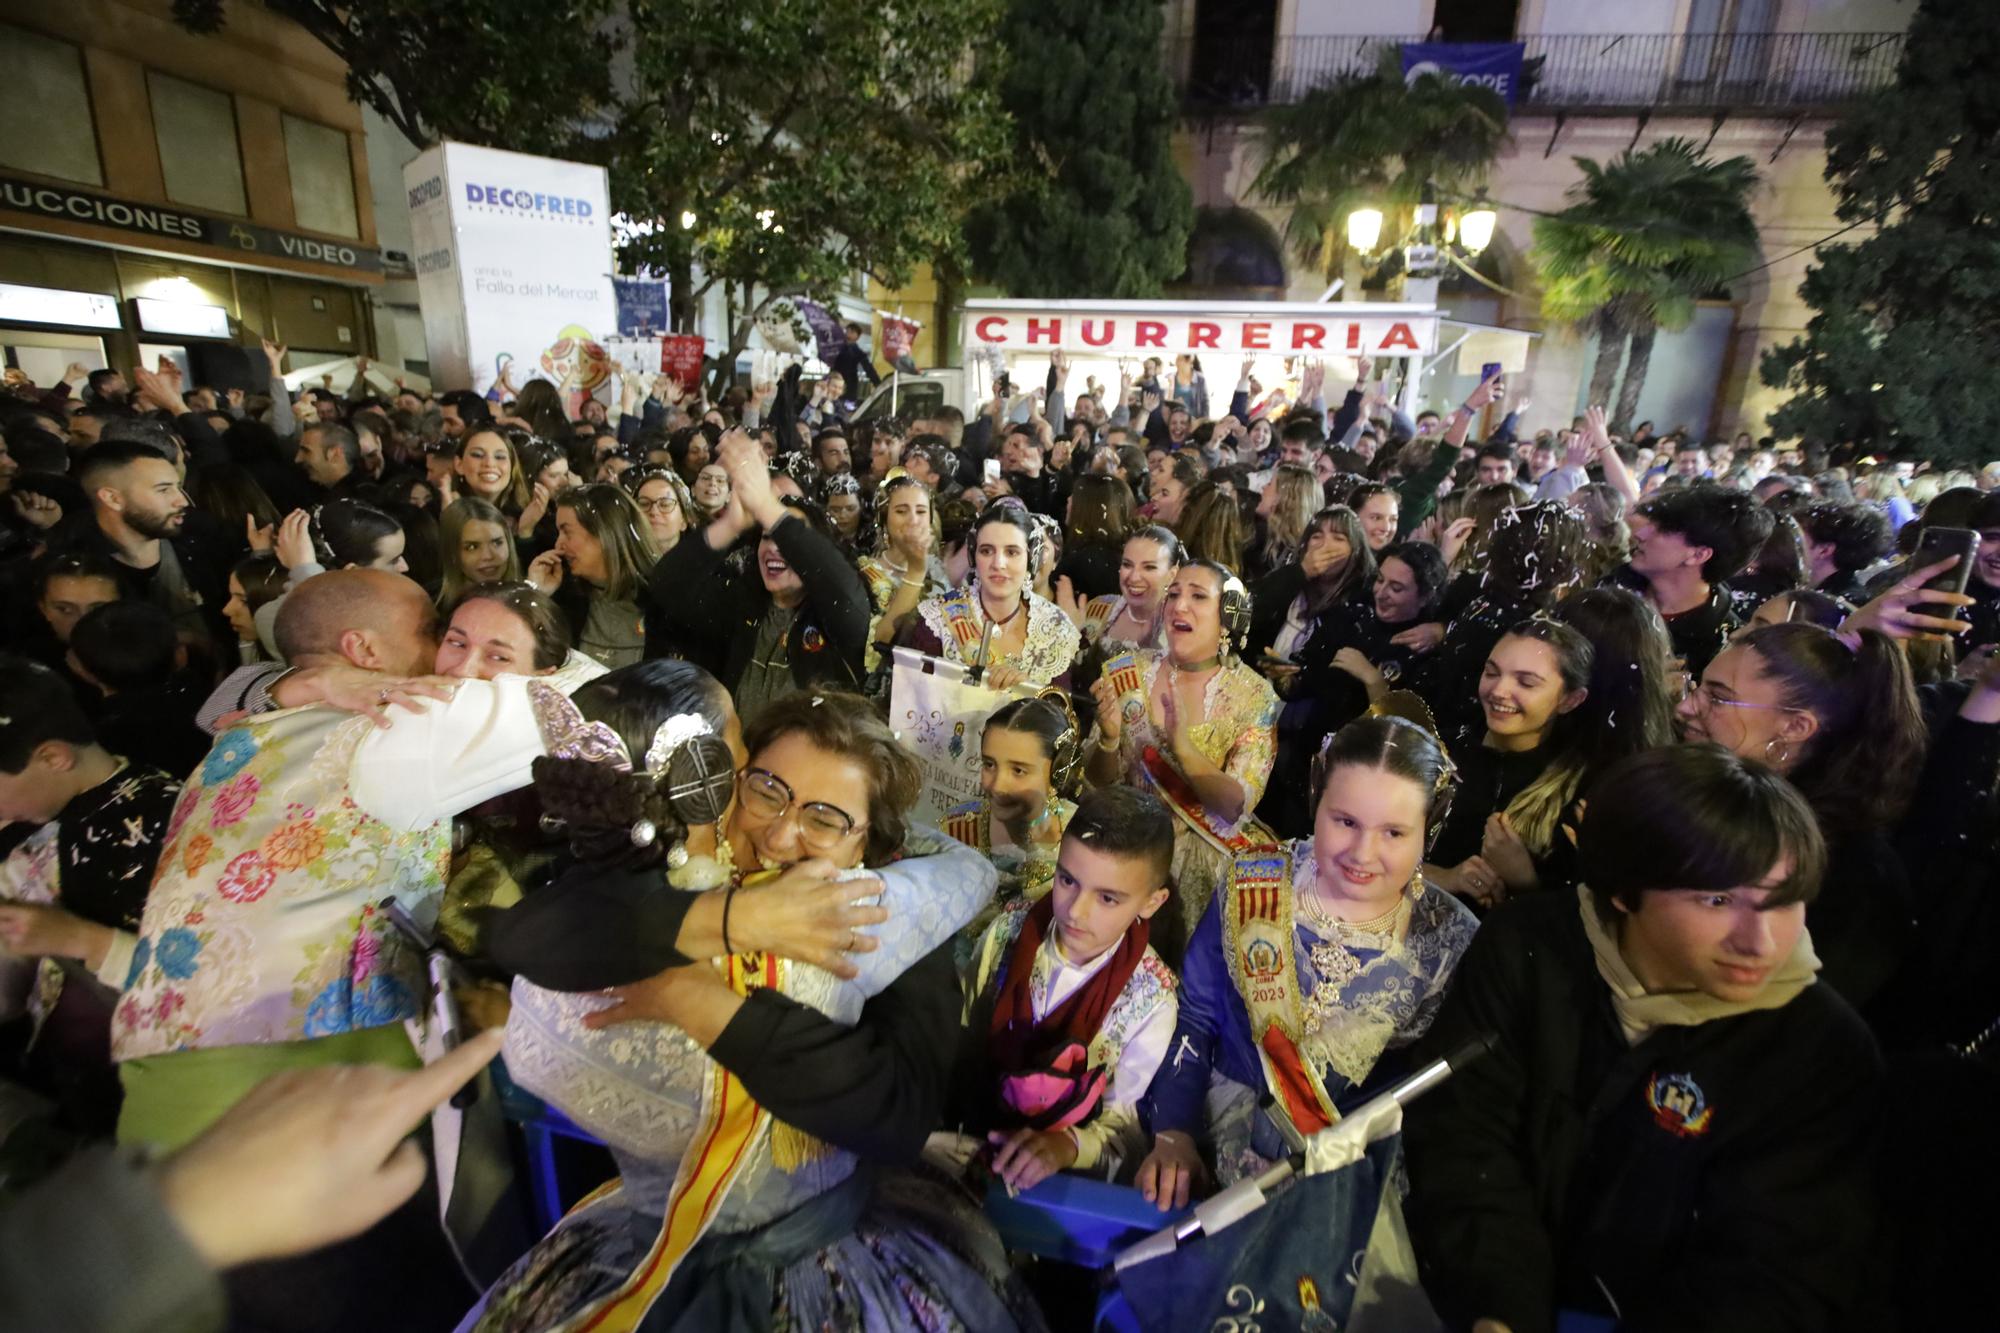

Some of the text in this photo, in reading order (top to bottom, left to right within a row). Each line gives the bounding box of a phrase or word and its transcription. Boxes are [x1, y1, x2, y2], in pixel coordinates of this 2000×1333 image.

[0, 183, 203, 238] UCCIONES
[465, 183, 593, 218] DECOFRED
[279, 235, 357, 266] VIDEO
[475, 277, 599, 301] Falla del Mercat
[974, 316, 1420, 350] CHURRERIA
[934, 766, 960, 791] LOCAL
[1252, 986, 1285, 1003] 2023
